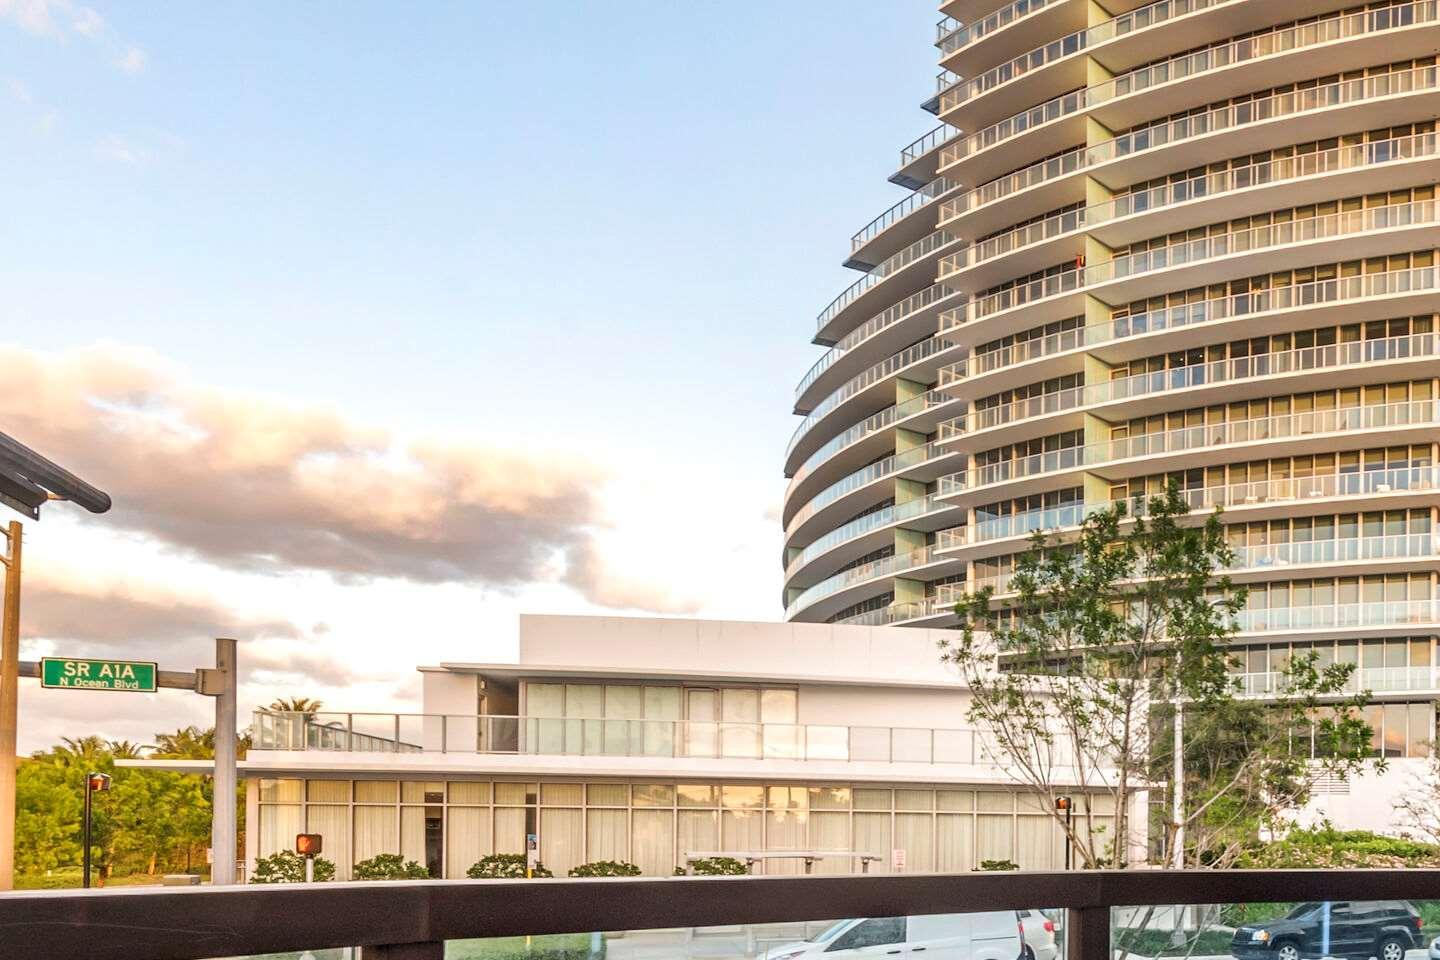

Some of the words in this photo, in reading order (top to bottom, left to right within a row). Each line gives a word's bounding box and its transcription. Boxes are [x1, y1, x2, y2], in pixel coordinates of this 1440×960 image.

[64, 661, 91, 677] SR
[99, 663, 136, 679] A1A
[60, 677, 69, 686] N
[74, 678, 110, 688] Ocean
[114, 680, 139, 689] Blvd
